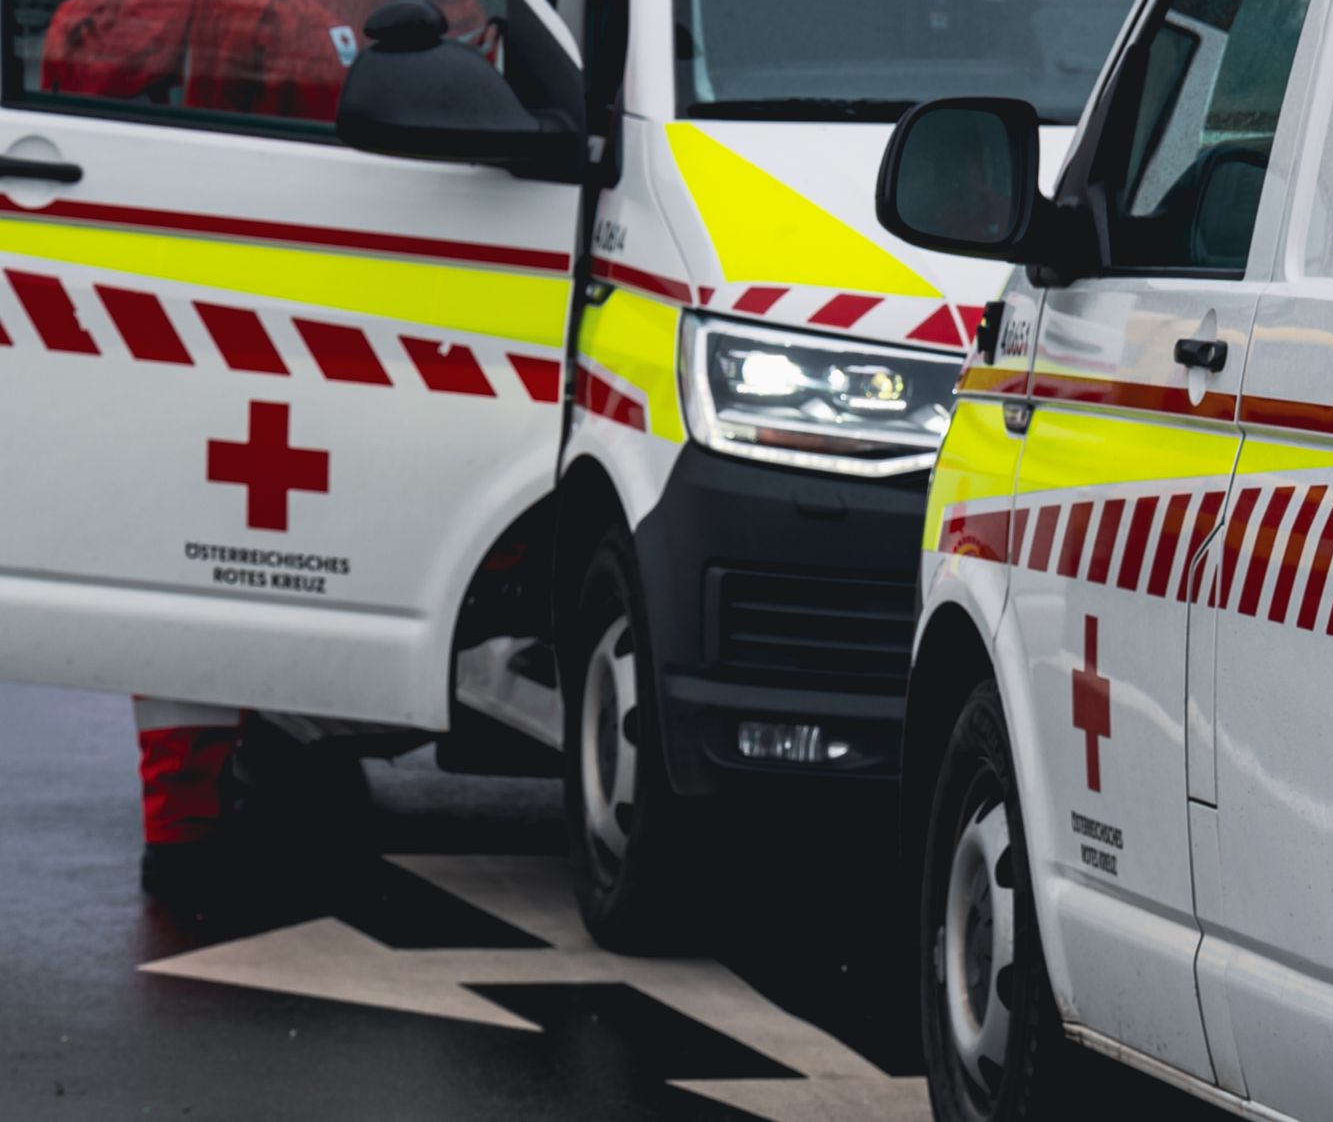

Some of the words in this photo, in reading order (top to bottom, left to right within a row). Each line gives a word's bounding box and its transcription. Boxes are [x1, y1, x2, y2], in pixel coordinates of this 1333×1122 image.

[184, 540, 351, 576] ÖSTERREICHISCHES
[213, 566, 267, 588] ROTES
[271, 571, 327, 594] KREUZ
